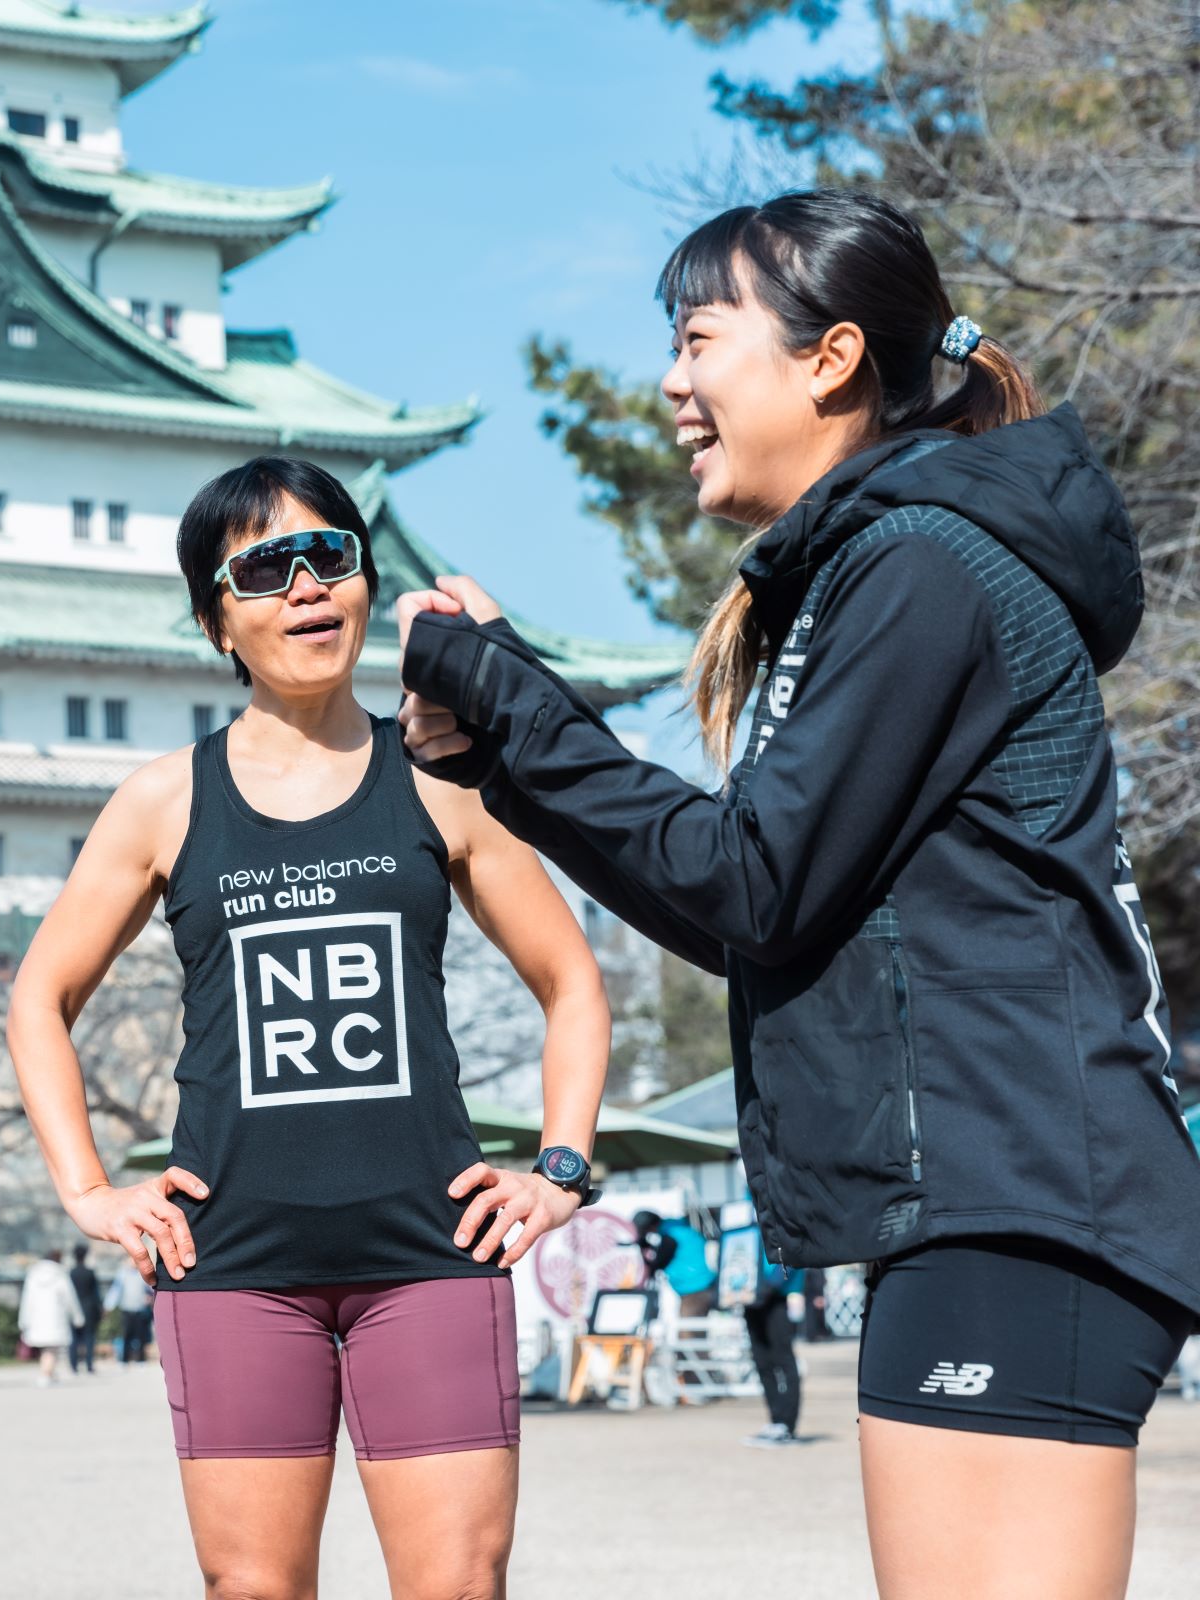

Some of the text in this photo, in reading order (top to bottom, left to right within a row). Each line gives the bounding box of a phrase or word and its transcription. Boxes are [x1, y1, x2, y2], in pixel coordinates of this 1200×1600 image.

[218, 855, 397, 892] new balance
[222, 883, 337, 919] run club
[257, 942, 382, 1007] NB
[262, 1012, 384, 1078] RC
